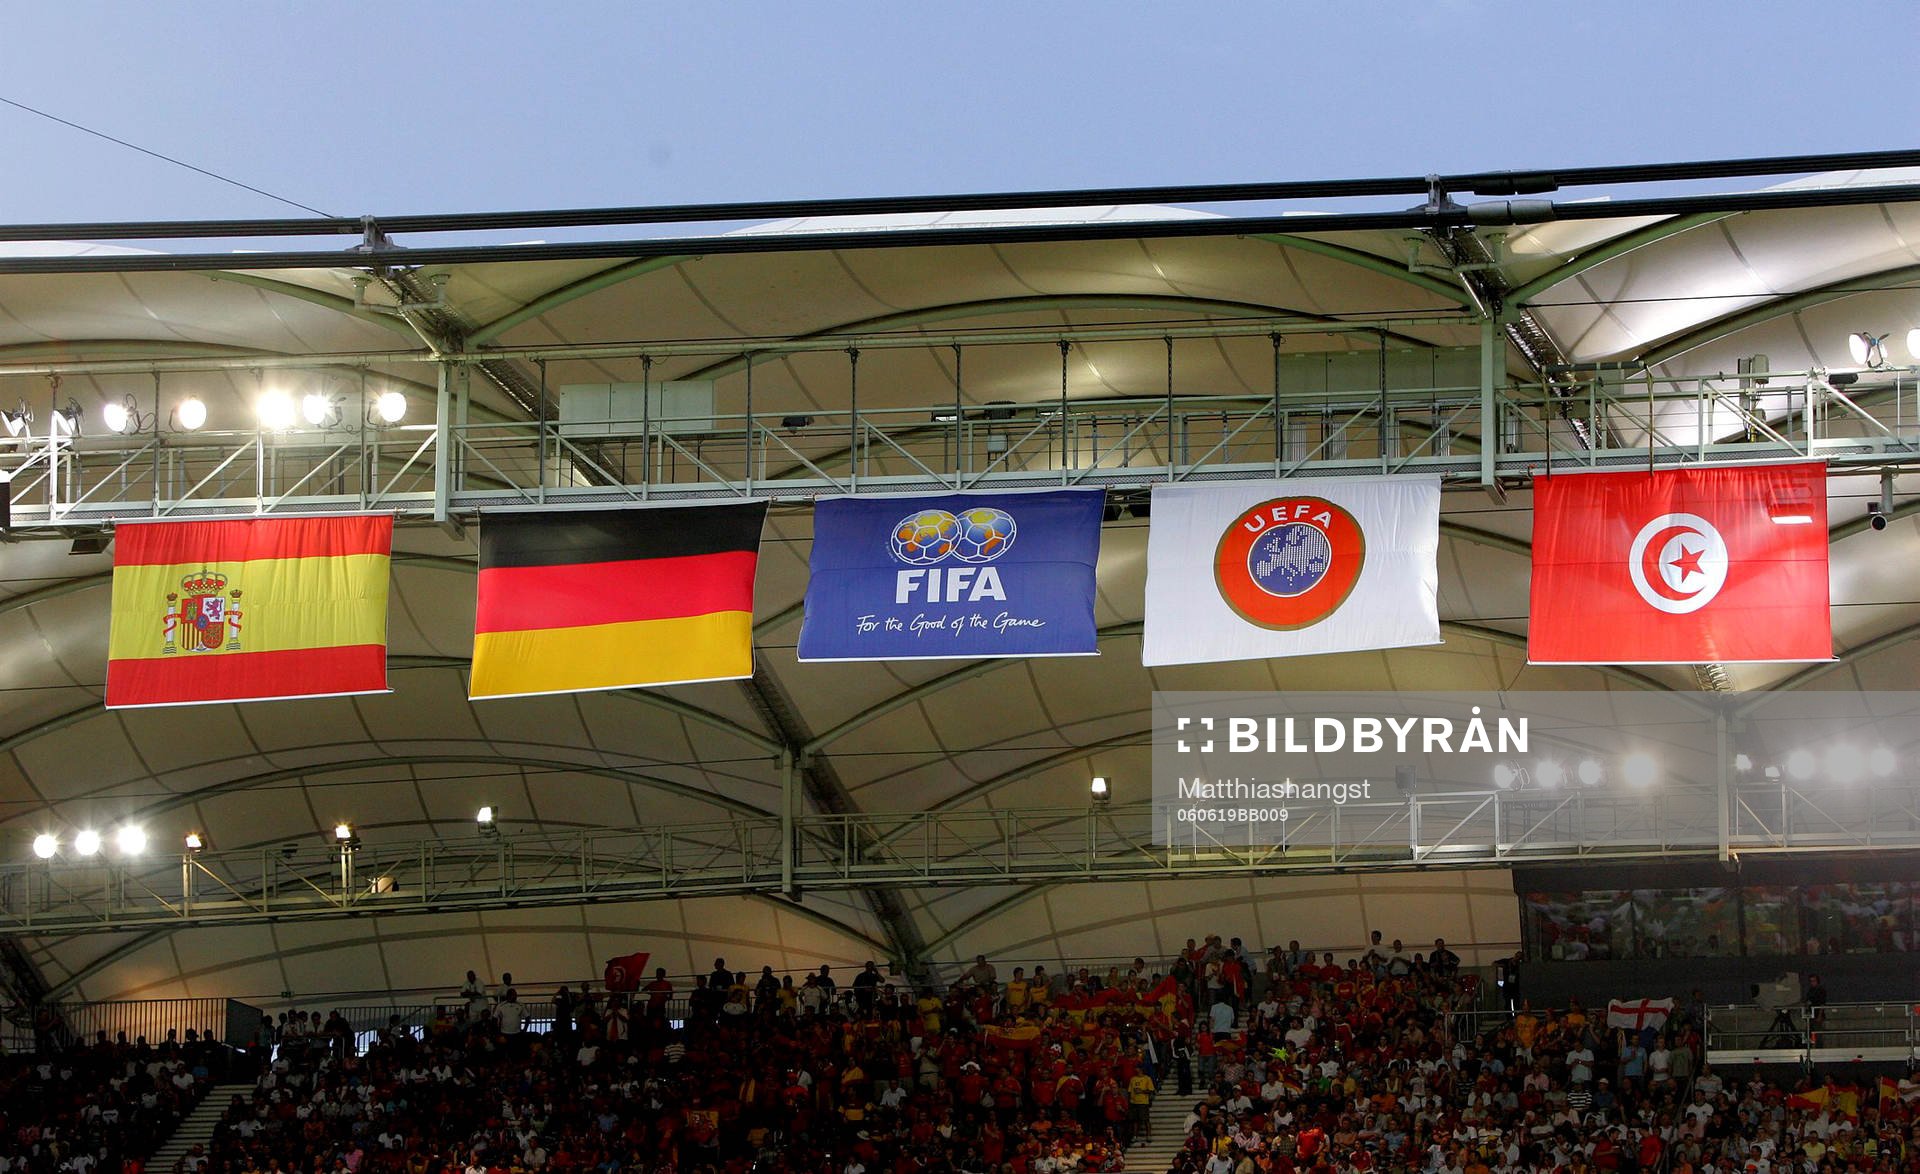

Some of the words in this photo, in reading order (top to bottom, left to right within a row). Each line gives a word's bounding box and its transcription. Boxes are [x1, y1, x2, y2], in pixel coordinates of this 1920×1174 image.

[1244, 505, 1332, 533] UEFA
[896, 567, 1007, 603] FIFA
[856, 615, 880, 635] For
[885, 617, 903, 631] the
[909, 613, 946, 637] Good
[950, 615, 965, 637] of
[969, 613, 988, 629] the
[993, 611, 1046, 634] Game
